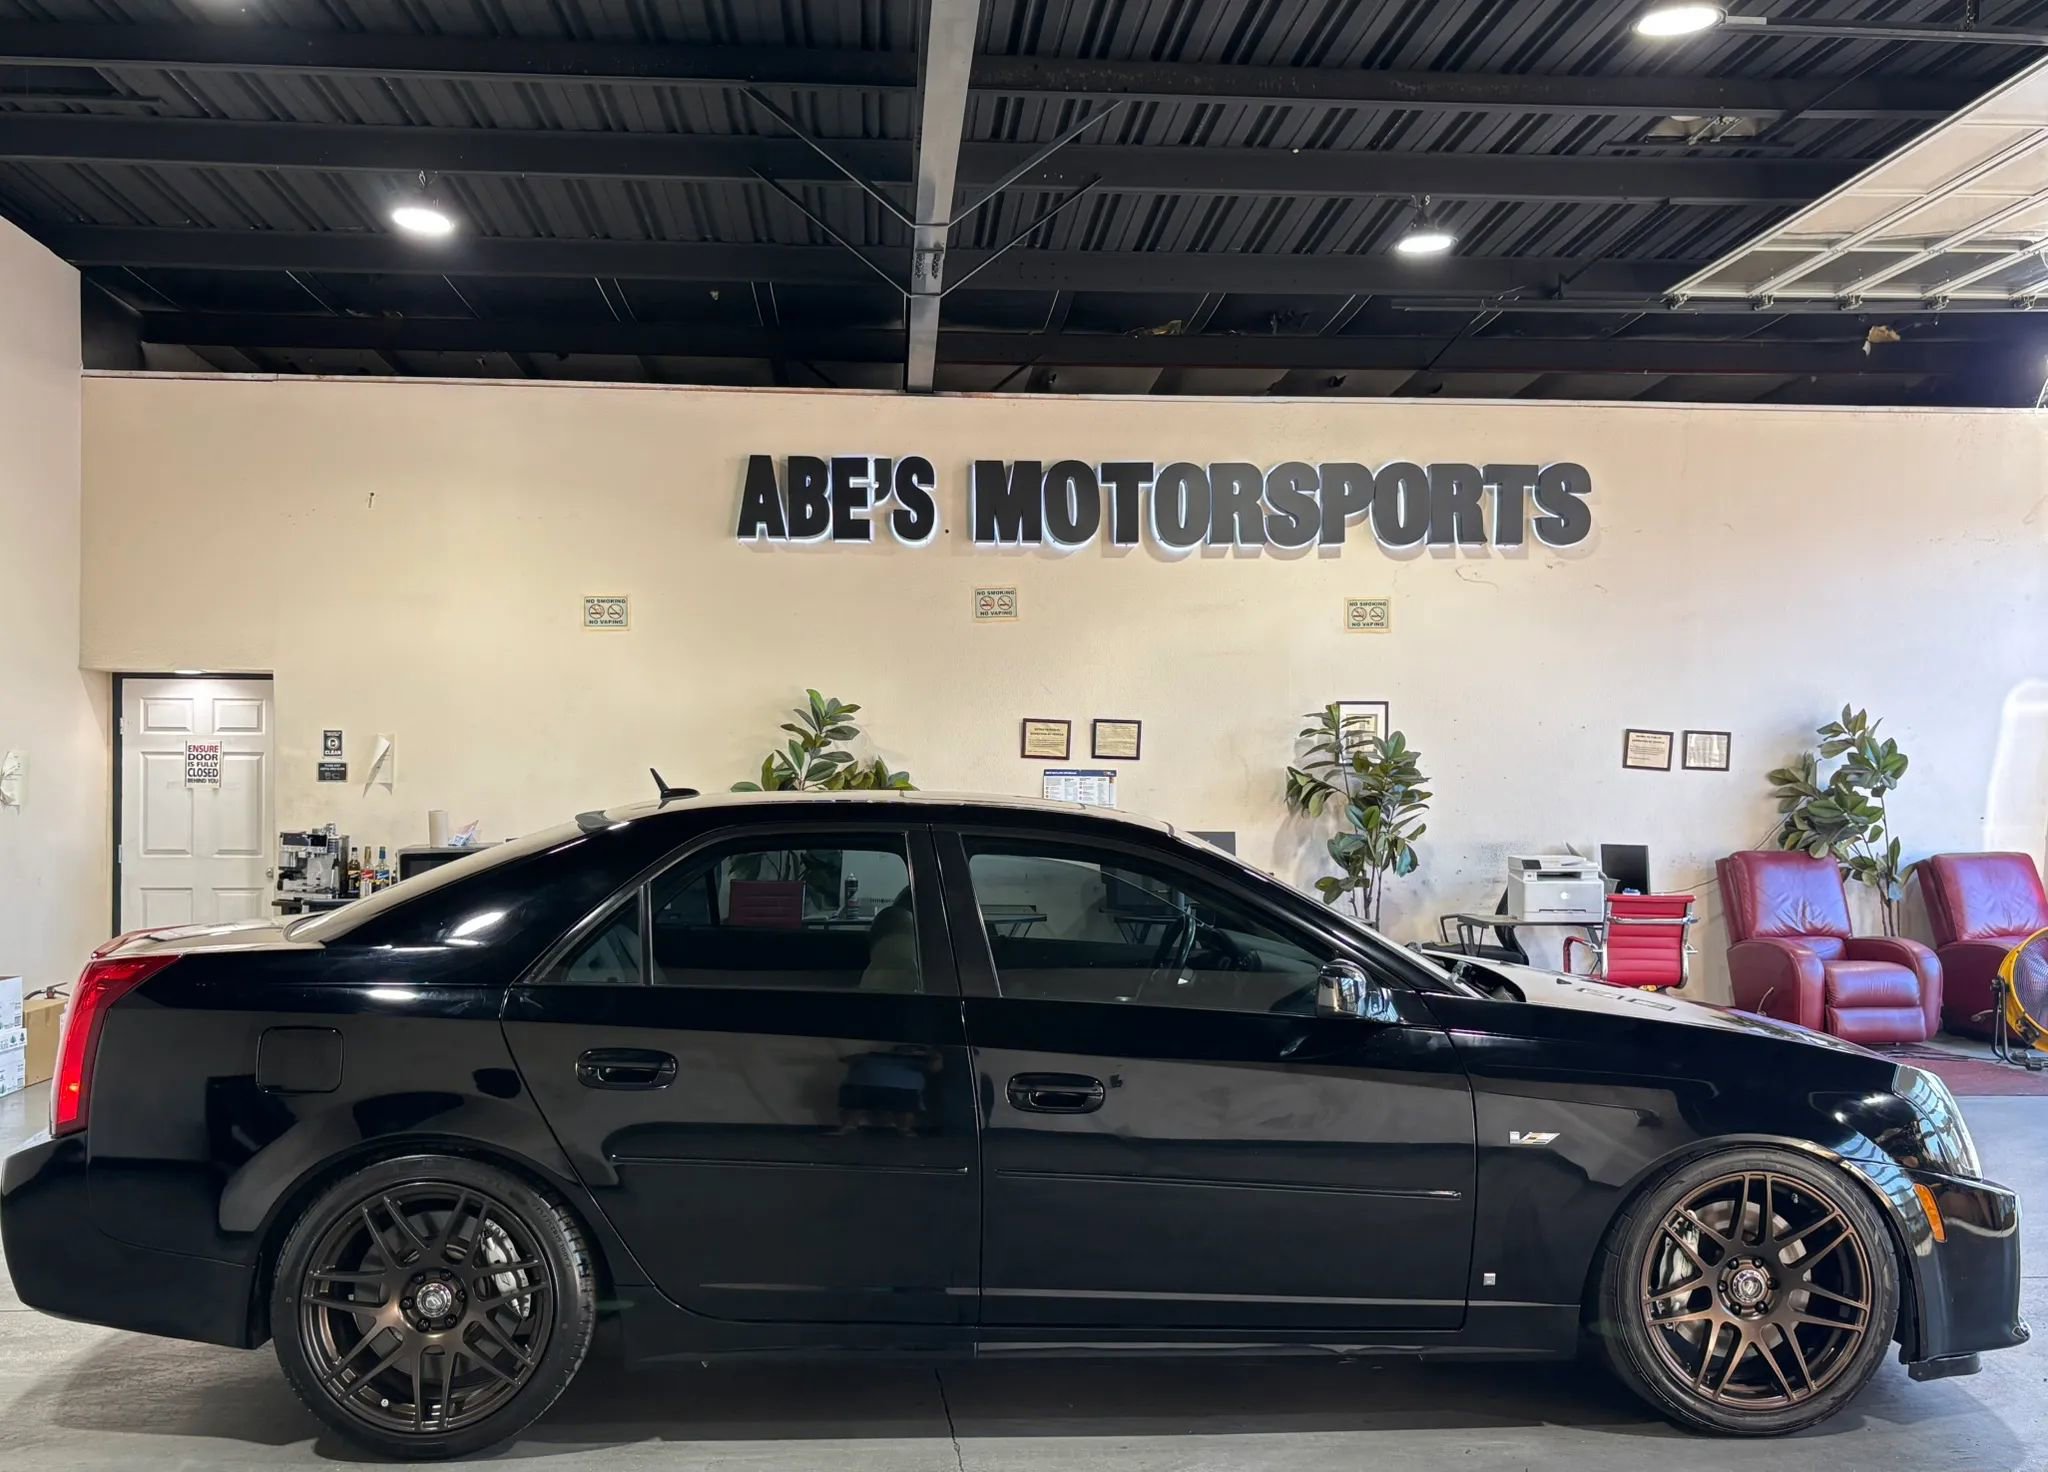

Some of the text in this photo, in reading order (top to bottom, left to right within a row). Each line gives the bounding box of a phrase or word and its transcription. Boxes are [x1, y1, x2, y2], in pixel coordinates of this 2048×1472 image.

[737, 455, 1593, 549] ABE'S MOTORSPORTS
[188, 768, 218, 777] CLOSED
